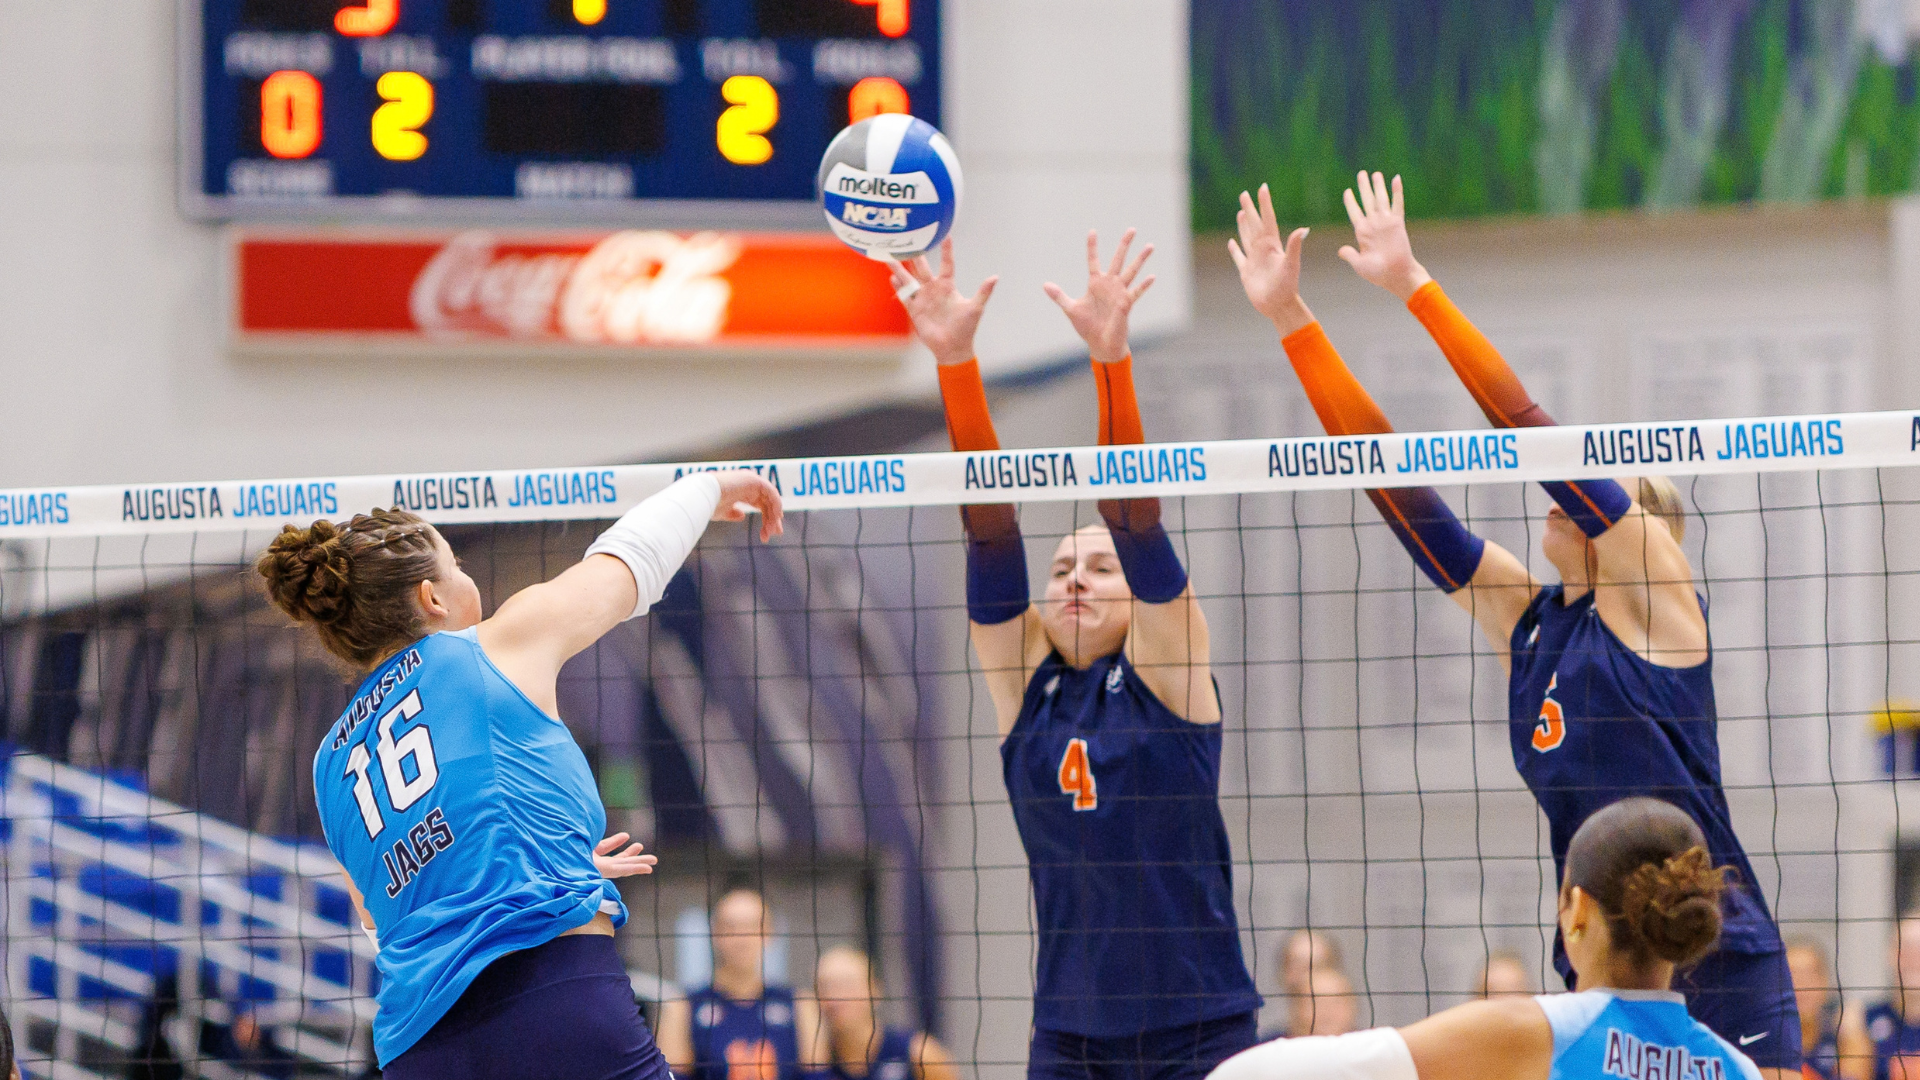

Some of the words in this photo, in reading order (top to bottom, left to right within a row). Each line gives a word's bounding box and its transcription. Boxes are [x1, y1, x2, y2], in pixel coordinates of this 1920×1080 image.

[260, 70, 323, 159] 0
[371, 71, 434, 161] 2
[716, 75, 779, 165] 2
[839, 176, 915, 199] molten
[842, 201, 908, 229] NCAA
[1268, 439, 1386, 477] AUGUSTA
[1397, 434, 1519, 472] JAGUARS
[1583, 426, 1705, 466] AUGUSTA
[1717, 420, 1844, 460] JAGUARS
[793, 459, 906, 496] JAGUARS
[965, 453, 1077, 490] AUGUSTA
[1089, 447, 1207, 485] JAGUARS
[122, 486, 223, 522] AUGUSTA
[233, 482, 338, 518] JAGUARS
[393, 476, 498, 510] AUGUSTA
[507, 471, 617, 507] JAGUARS
[342, 687, 440, 843] 16
[1058, 737, 1098, 812] 4
[382, 806, 455, 898] JAGS
